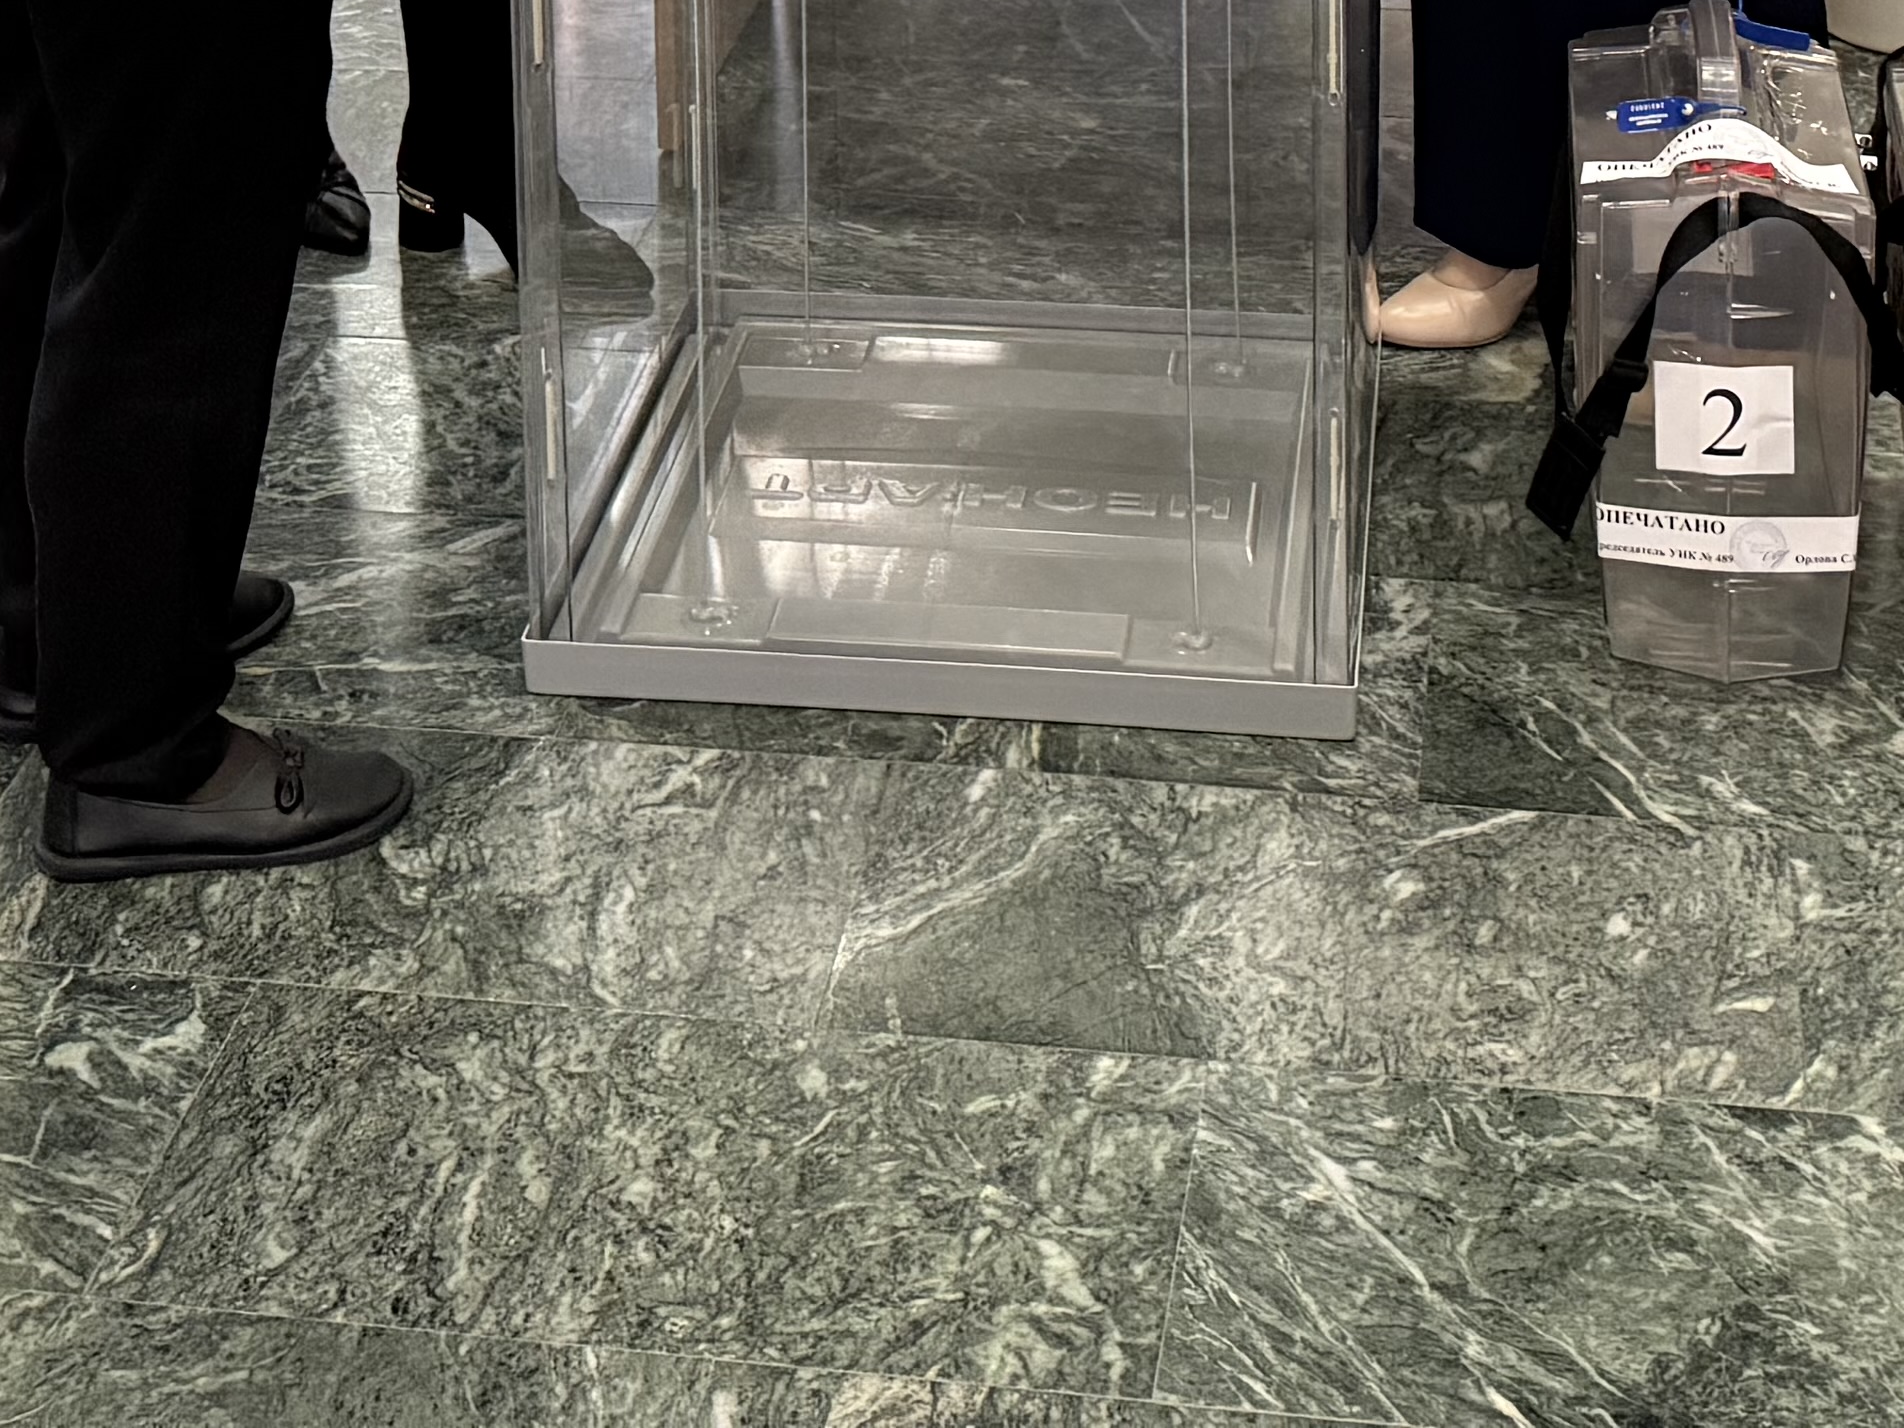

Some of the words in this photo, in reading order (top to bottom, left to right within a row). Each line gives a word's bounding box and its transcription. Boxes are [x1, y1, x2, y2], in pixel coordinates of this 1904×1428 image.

[1701, 388, 1747, 457] 2
[1669, 547, 1697, 561] УИК
[1699, 552, 1713, 563] №
[1716, 553, 1734, 564] 489
[1795, 553, 1838, 565] Орлова
